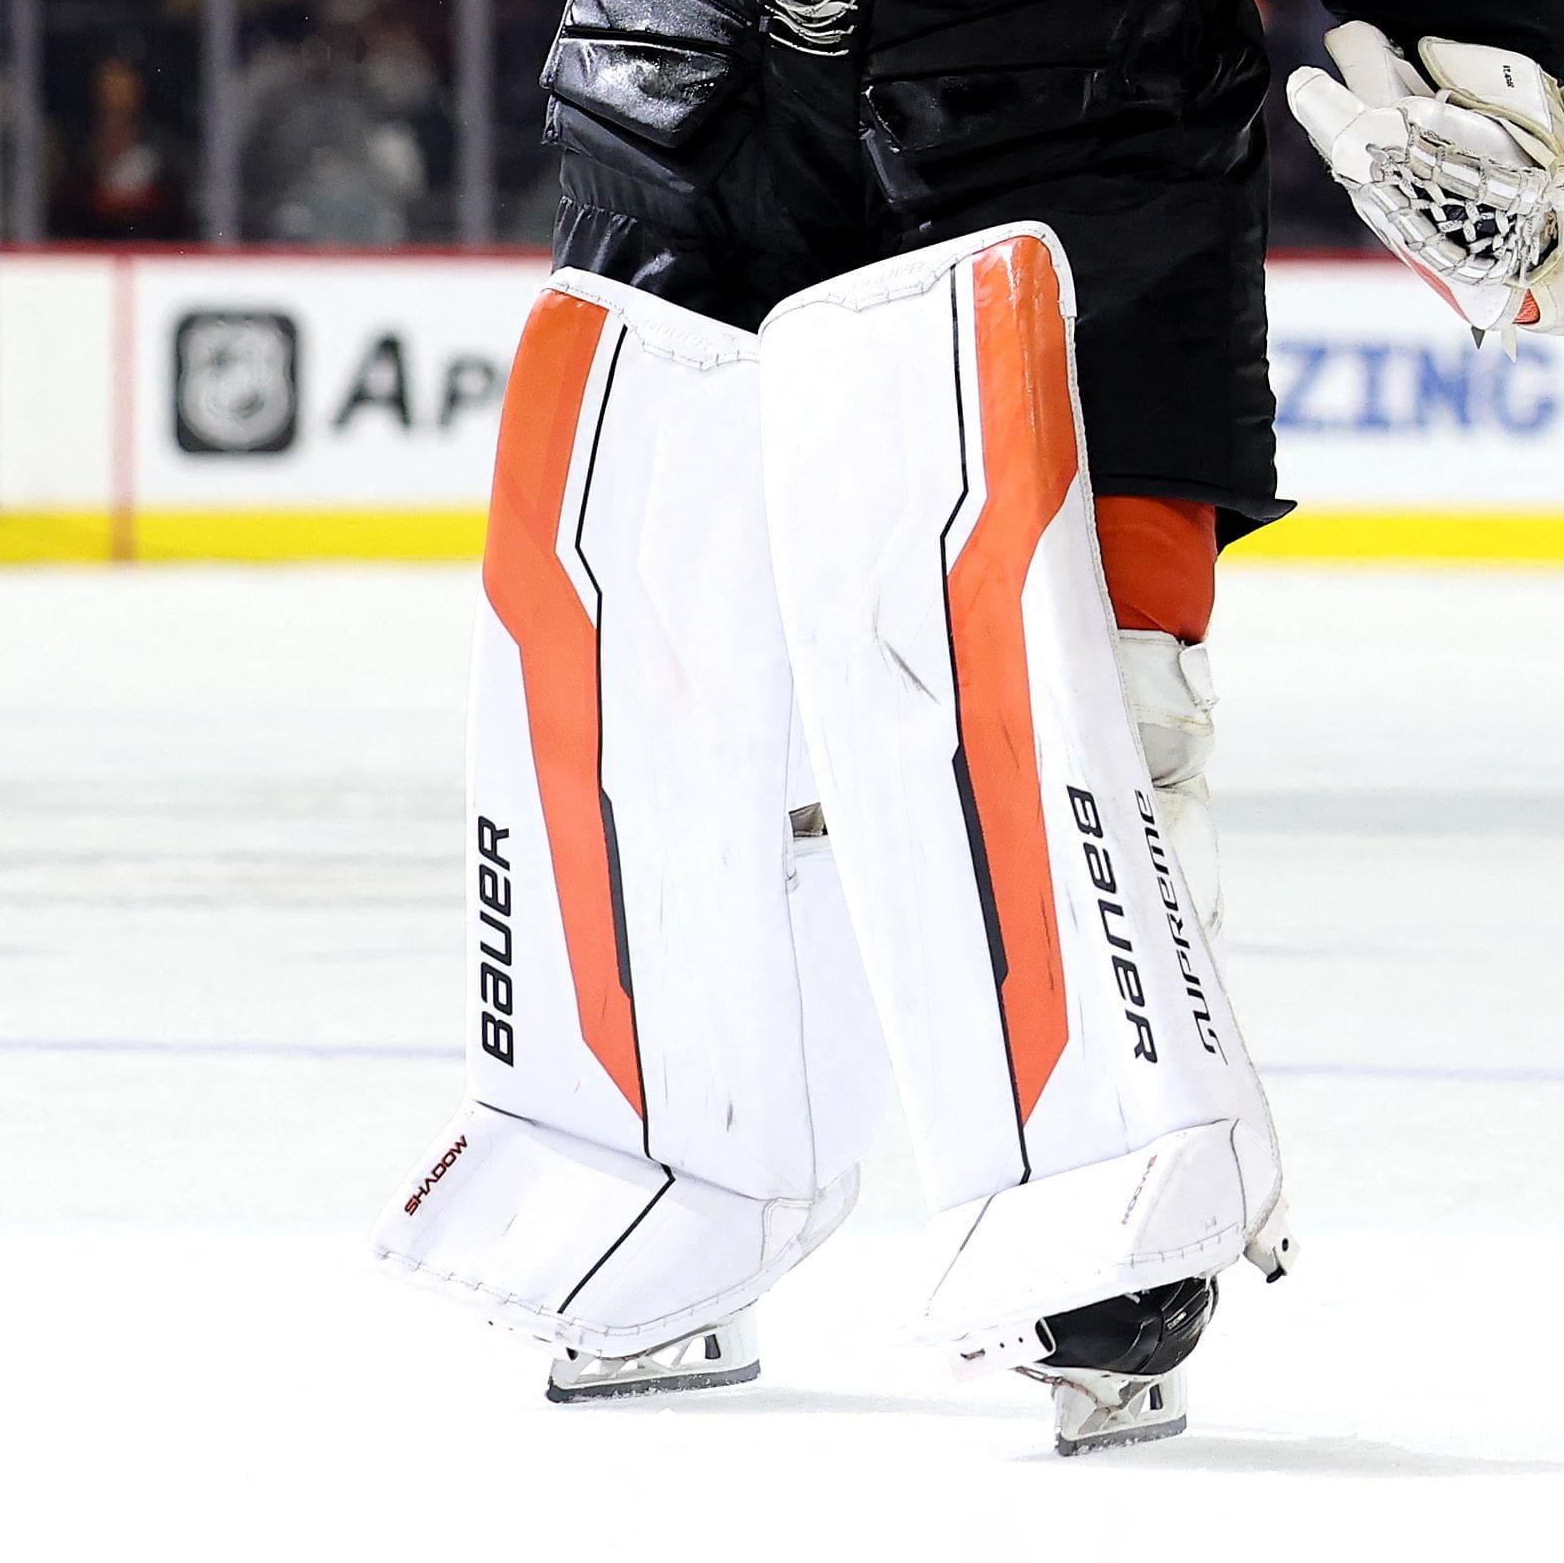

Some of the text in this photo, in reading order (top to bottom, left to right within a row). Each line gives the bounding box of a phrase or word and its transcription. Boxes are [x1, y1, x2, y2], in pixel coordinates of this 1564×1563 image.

[477, 815, 514, 1068] BAUER
[1066, 784, 1159, 1064] BAUER
[403, 1135, 468, 1217] SHADOW
